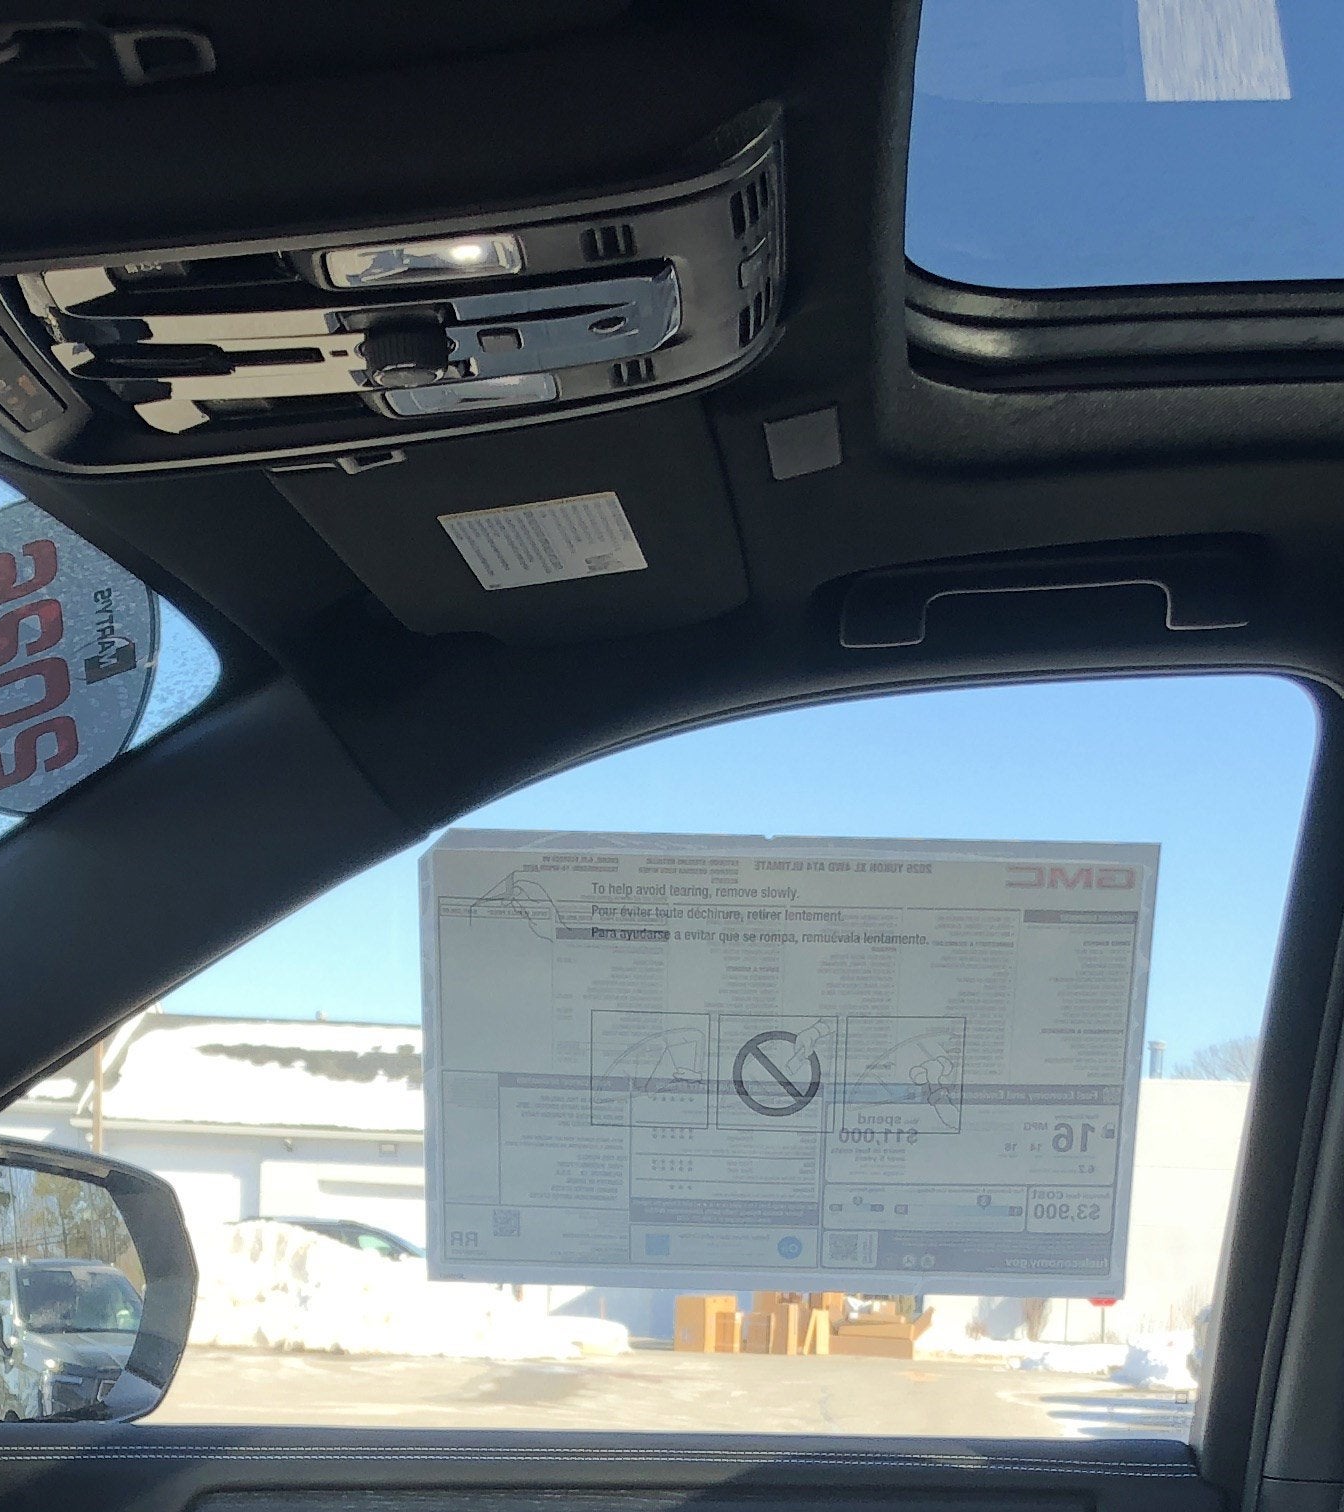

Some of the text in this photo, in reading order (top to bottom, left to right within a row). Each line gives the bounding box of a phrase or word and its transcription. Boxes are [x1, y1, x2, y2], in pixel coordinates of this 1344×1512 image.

[592, 882, 799, 901] To help avoid tearing, remove slowly.
[591, 904, 845, 922] Pour éviter toute déchirure, retirer lentement.
[591, 926, 618, 938] Para
[619, 928, 671, 942] ayudarse
[674, 932, 682, 940] a
[684, 930, 715, 941] evitar
[719, 933, 740, 944] que
[743, 933, 756, 942] se
[759, 933, 799, 945] rompa,
[802, 931, 861, 944] remuévala
[863, 932, 929, 946] lentamente.
